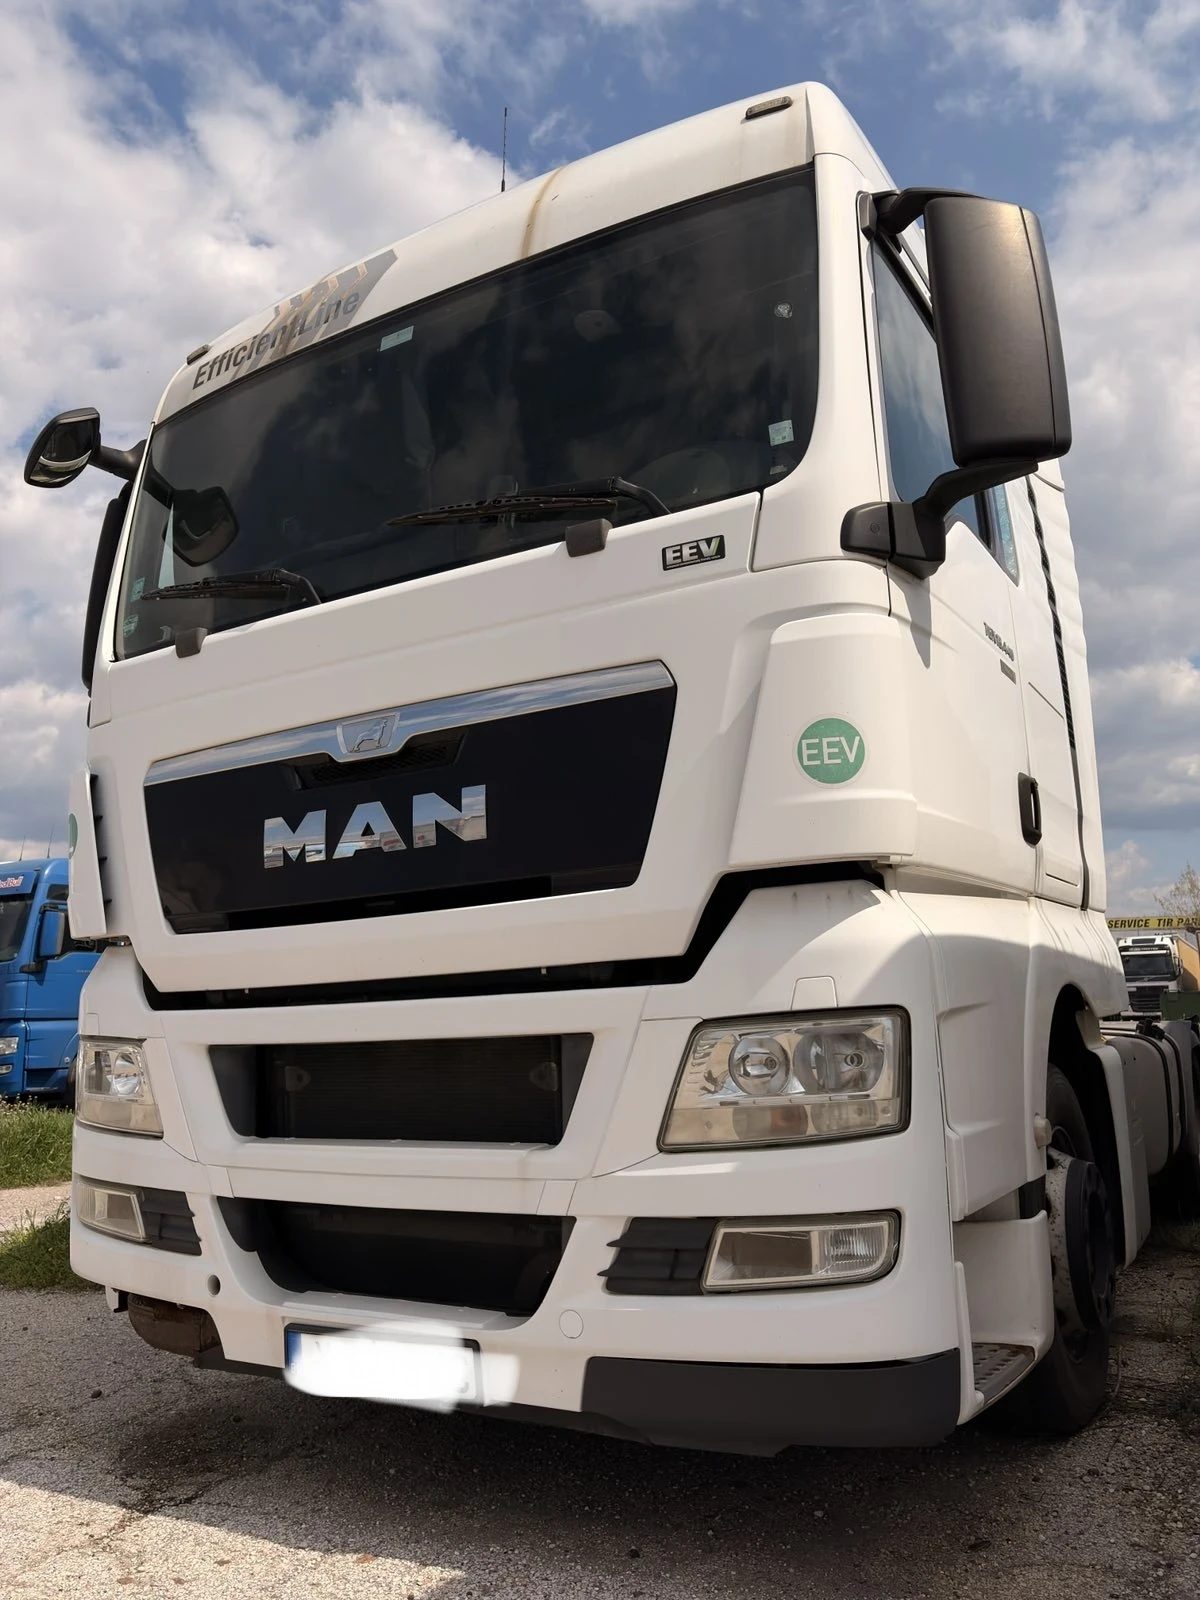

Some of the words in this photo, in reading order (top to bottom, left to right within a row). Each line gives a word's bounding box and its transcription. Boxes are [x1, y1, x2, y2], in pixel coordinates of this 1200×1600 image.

[665, 537, 721, 566] EEV
[801, 735, 860, 766] EEV
[264, 784, 487, 869] MAN
[1107, 918, 1151, 929] SERVICE
[1157, 918, 1174, 928] TIR
